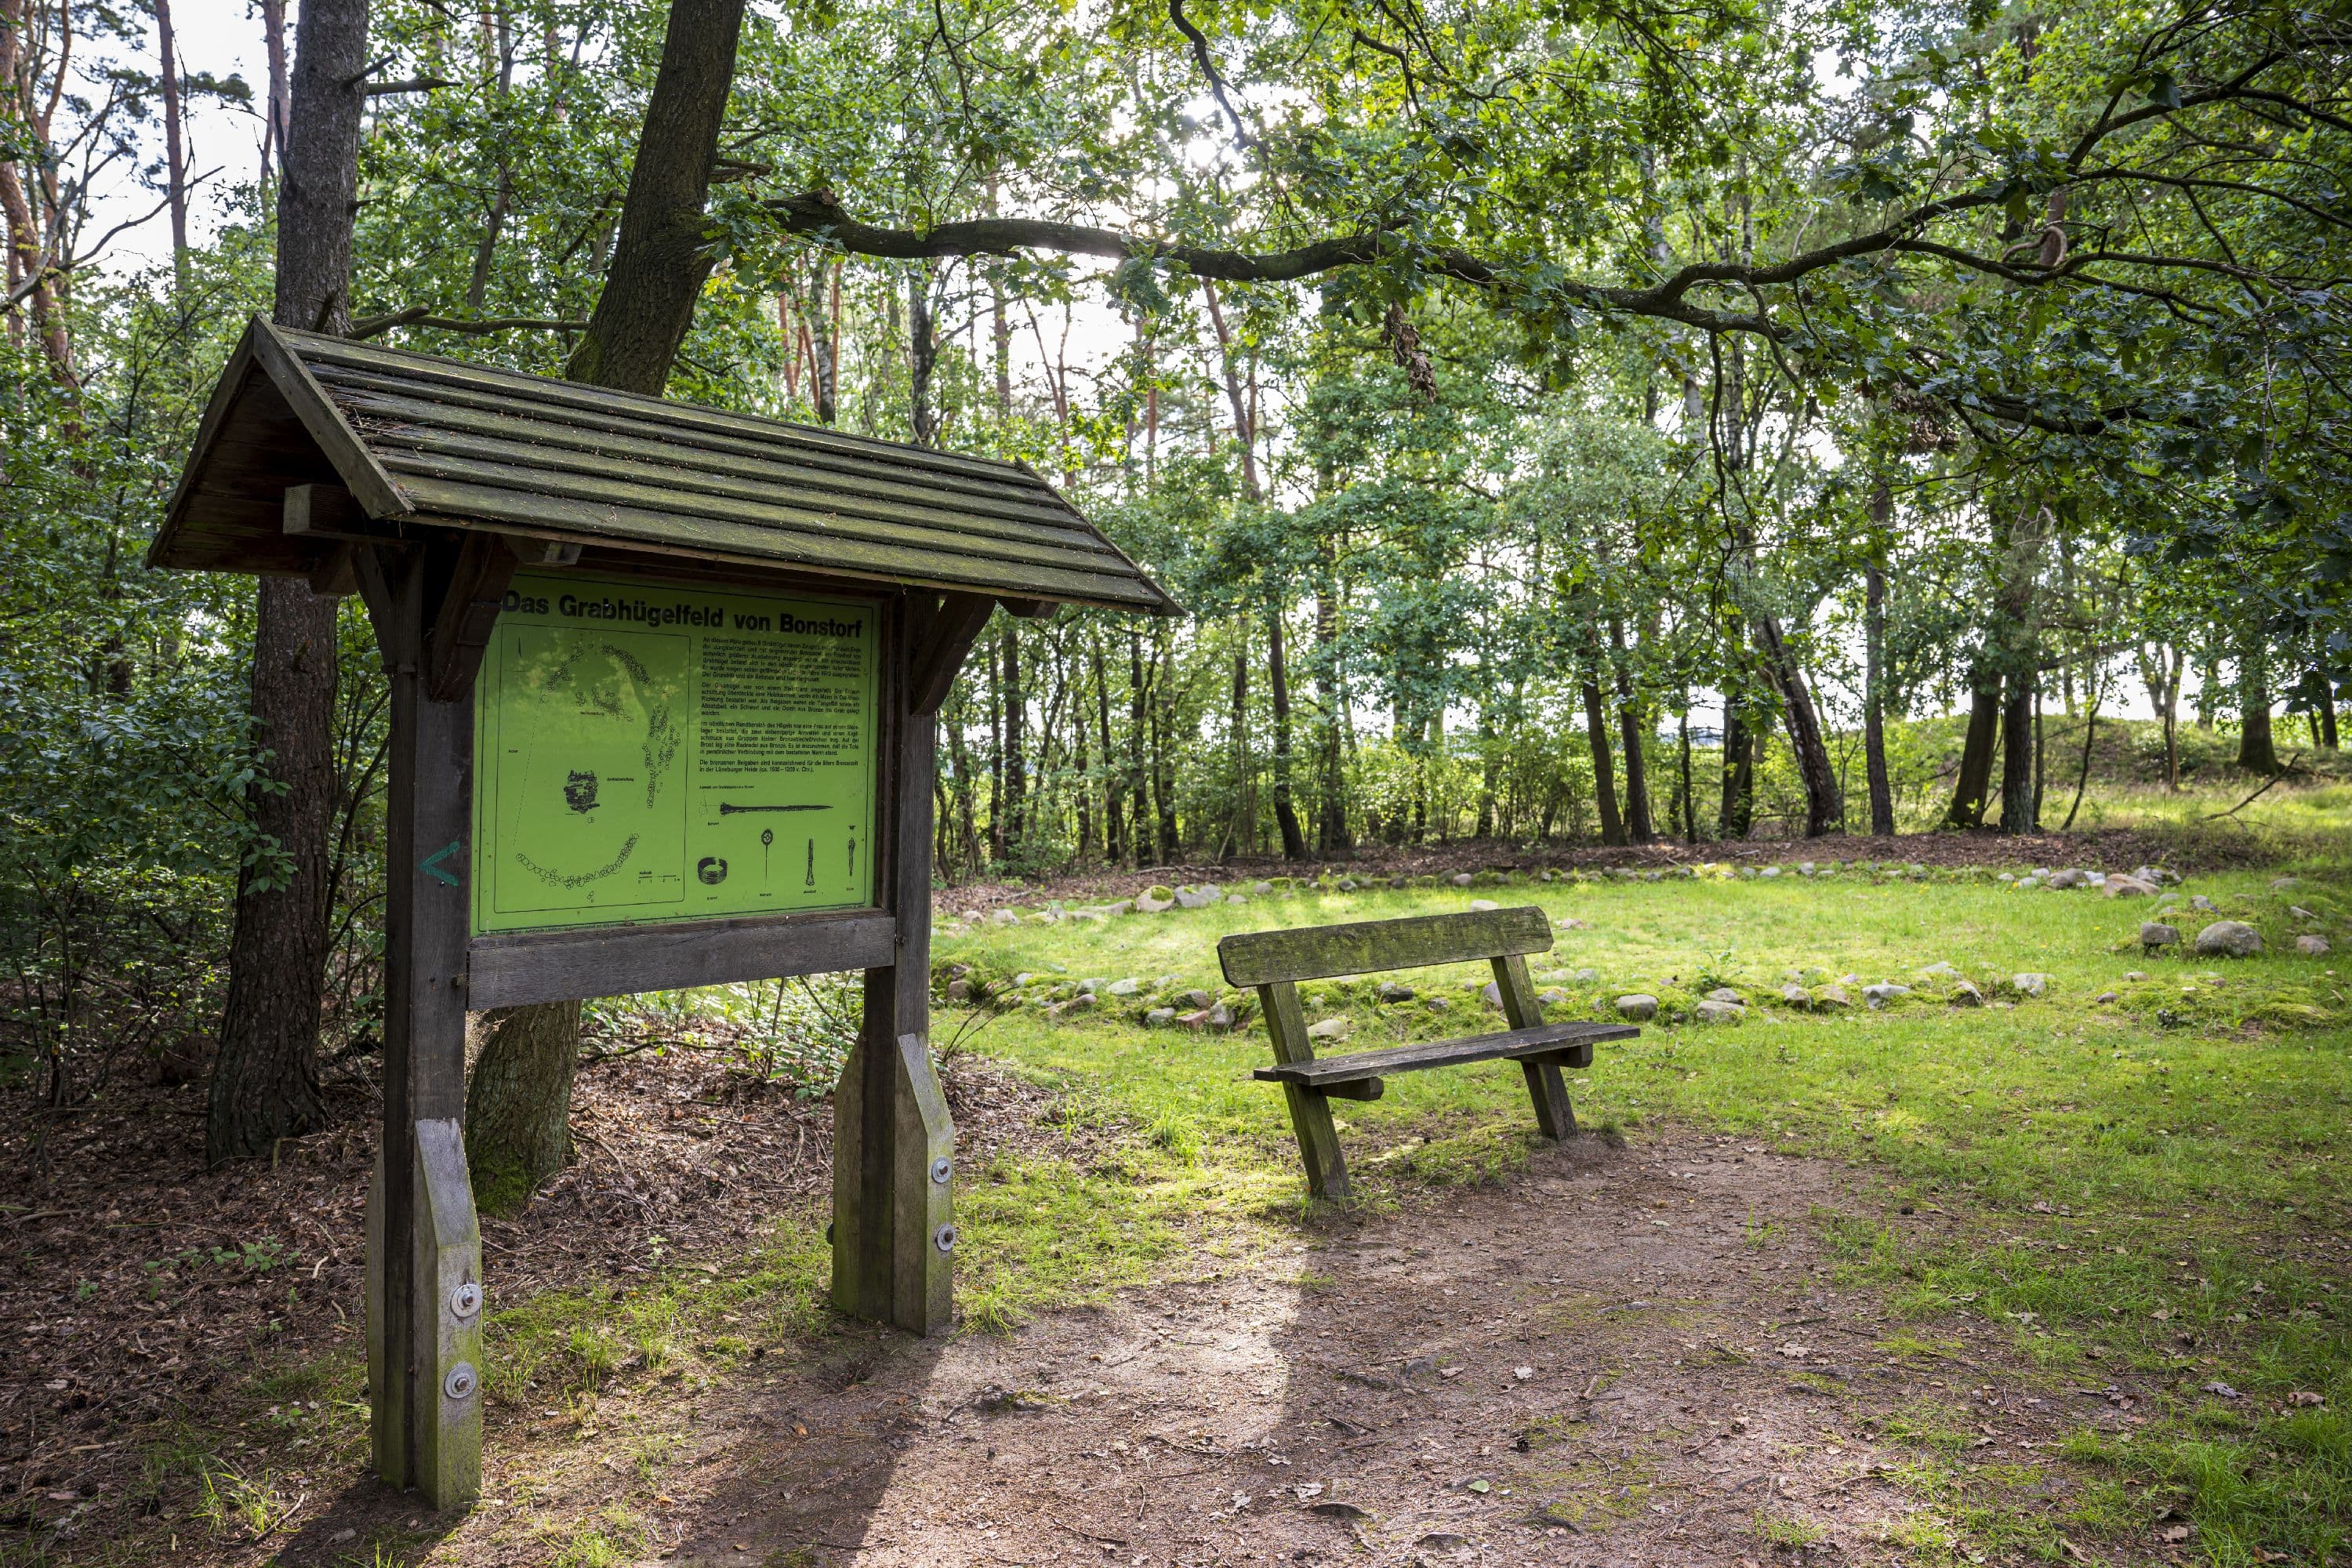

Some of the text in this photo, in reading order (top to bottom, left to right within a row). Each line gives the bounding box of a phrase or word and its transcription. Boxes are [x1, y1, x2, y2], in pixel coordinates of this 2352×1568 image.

[502, 590, 862, 639] Das Grabhügelfeld von Bonstorf
